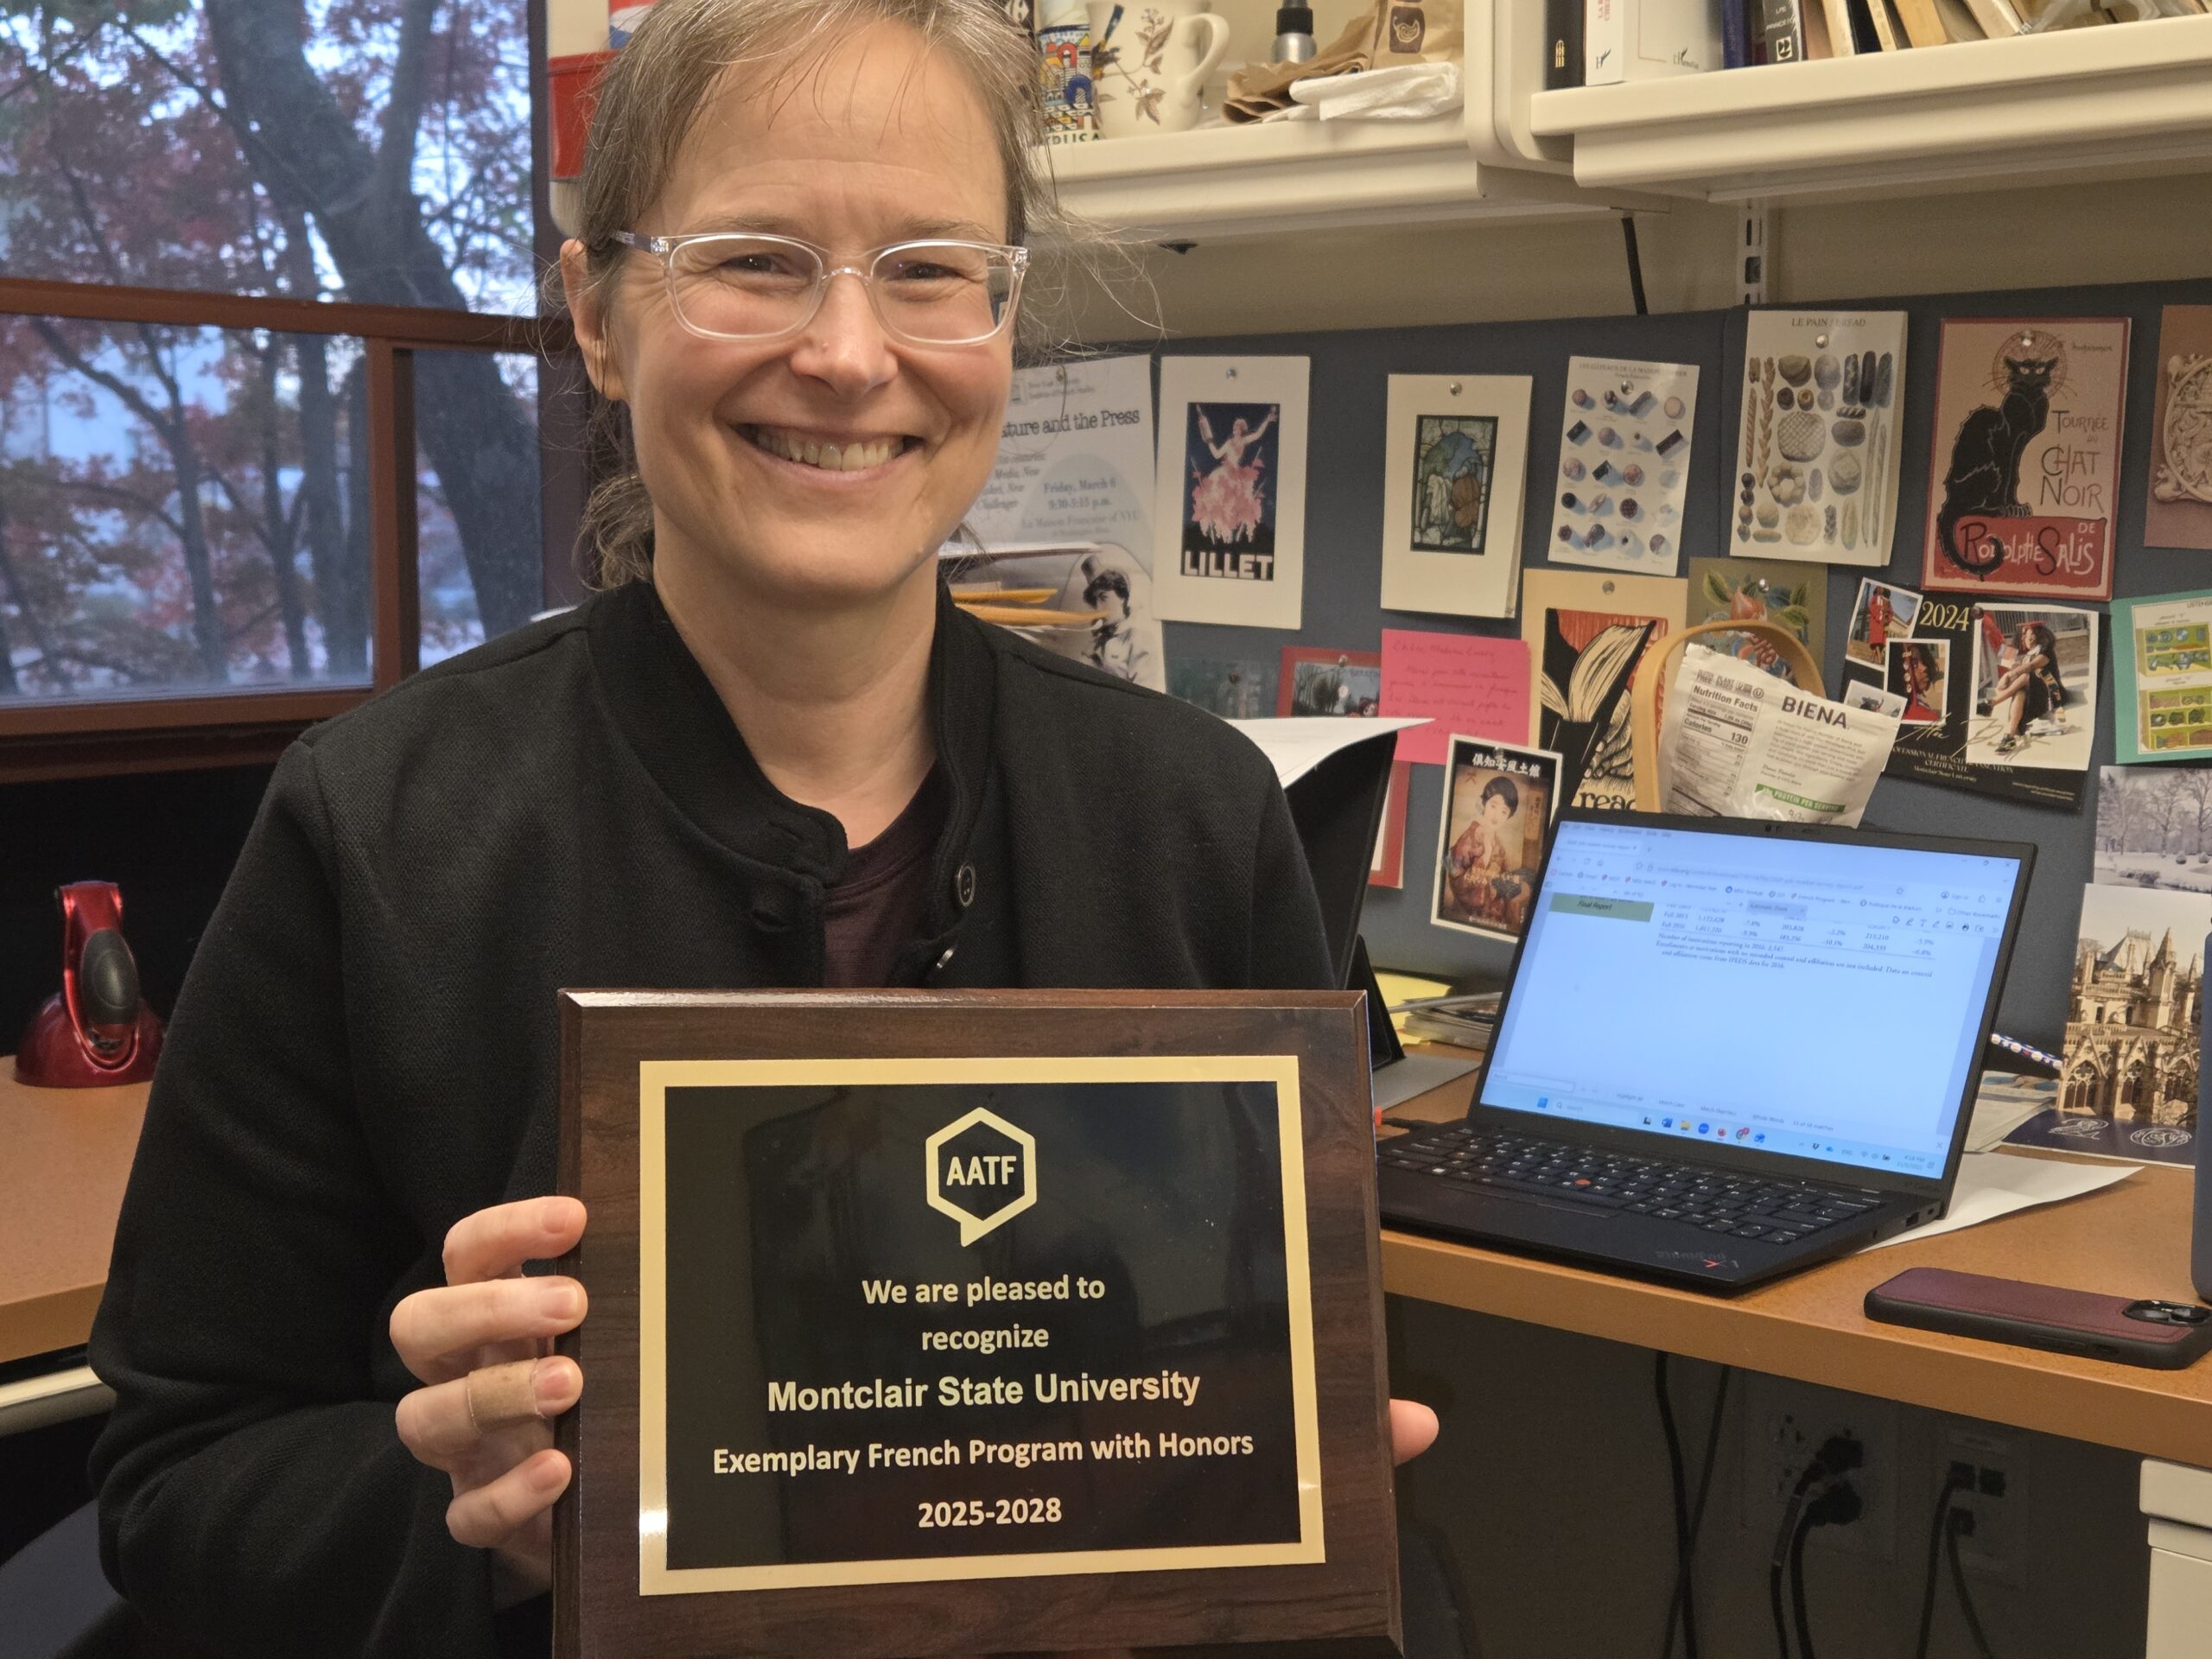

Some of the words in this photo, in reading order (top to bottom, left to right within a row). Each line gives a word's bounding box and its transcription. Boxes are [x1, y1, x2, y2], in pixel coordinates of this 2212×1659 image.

[1043, 415, 1071, 434] and
[1073, 412, 1098, 430] the
[1100, 410, 1141, 429] Press
[2041, 443, 2101, 484] CHAT
[1078, 478, 1107, 490] March
[2040, 476, 2105, 513] NOIR
[2078, 523, 2095, 534] DE
[1184, 550, 1273, 582] LILLET
[1919, 601, 1970, 632] 2024
[1694, 685, 1732, 705] Nutrition
[1733, 698, 1758, 713] Facts
[1782, 696, 1847, 729] BIENA
[1684, 717, 1713, 734] Calories
[1731, 732, 1749, 746] 130
[1774, 789, 1801, 804] PROTEIN
[1801, 798, 1815, 809] PER
[1577, 899, 1592, 909] Final
[1592, 901, 1612, 912] Report
[946, 1155, 1017, 1186] AATF
[861, 1279, 907, 1305] We
[915, 1283, 959, 1303] are
[967, 1274, 1070, 1307] pleased
[1076, 1276, 1105, 1300] to
[922, 1322, 1049, 1355] recognize
[767, 1377, 929, 1412] Montclair
[938, 1376, 1024, 1407] State
[1035, 1370, 1201, 1408] University
[713, 1444, 861, 1478] Exemplary
[868, 1439, 960, 1468] French
[969, 1440, 1083, 1471] Program
[1090, 1431, 1151, 1460] with
[1159, 1432, 1254, 1459] Honors
[918, 1497, 1062, 1529] 2025-2028
